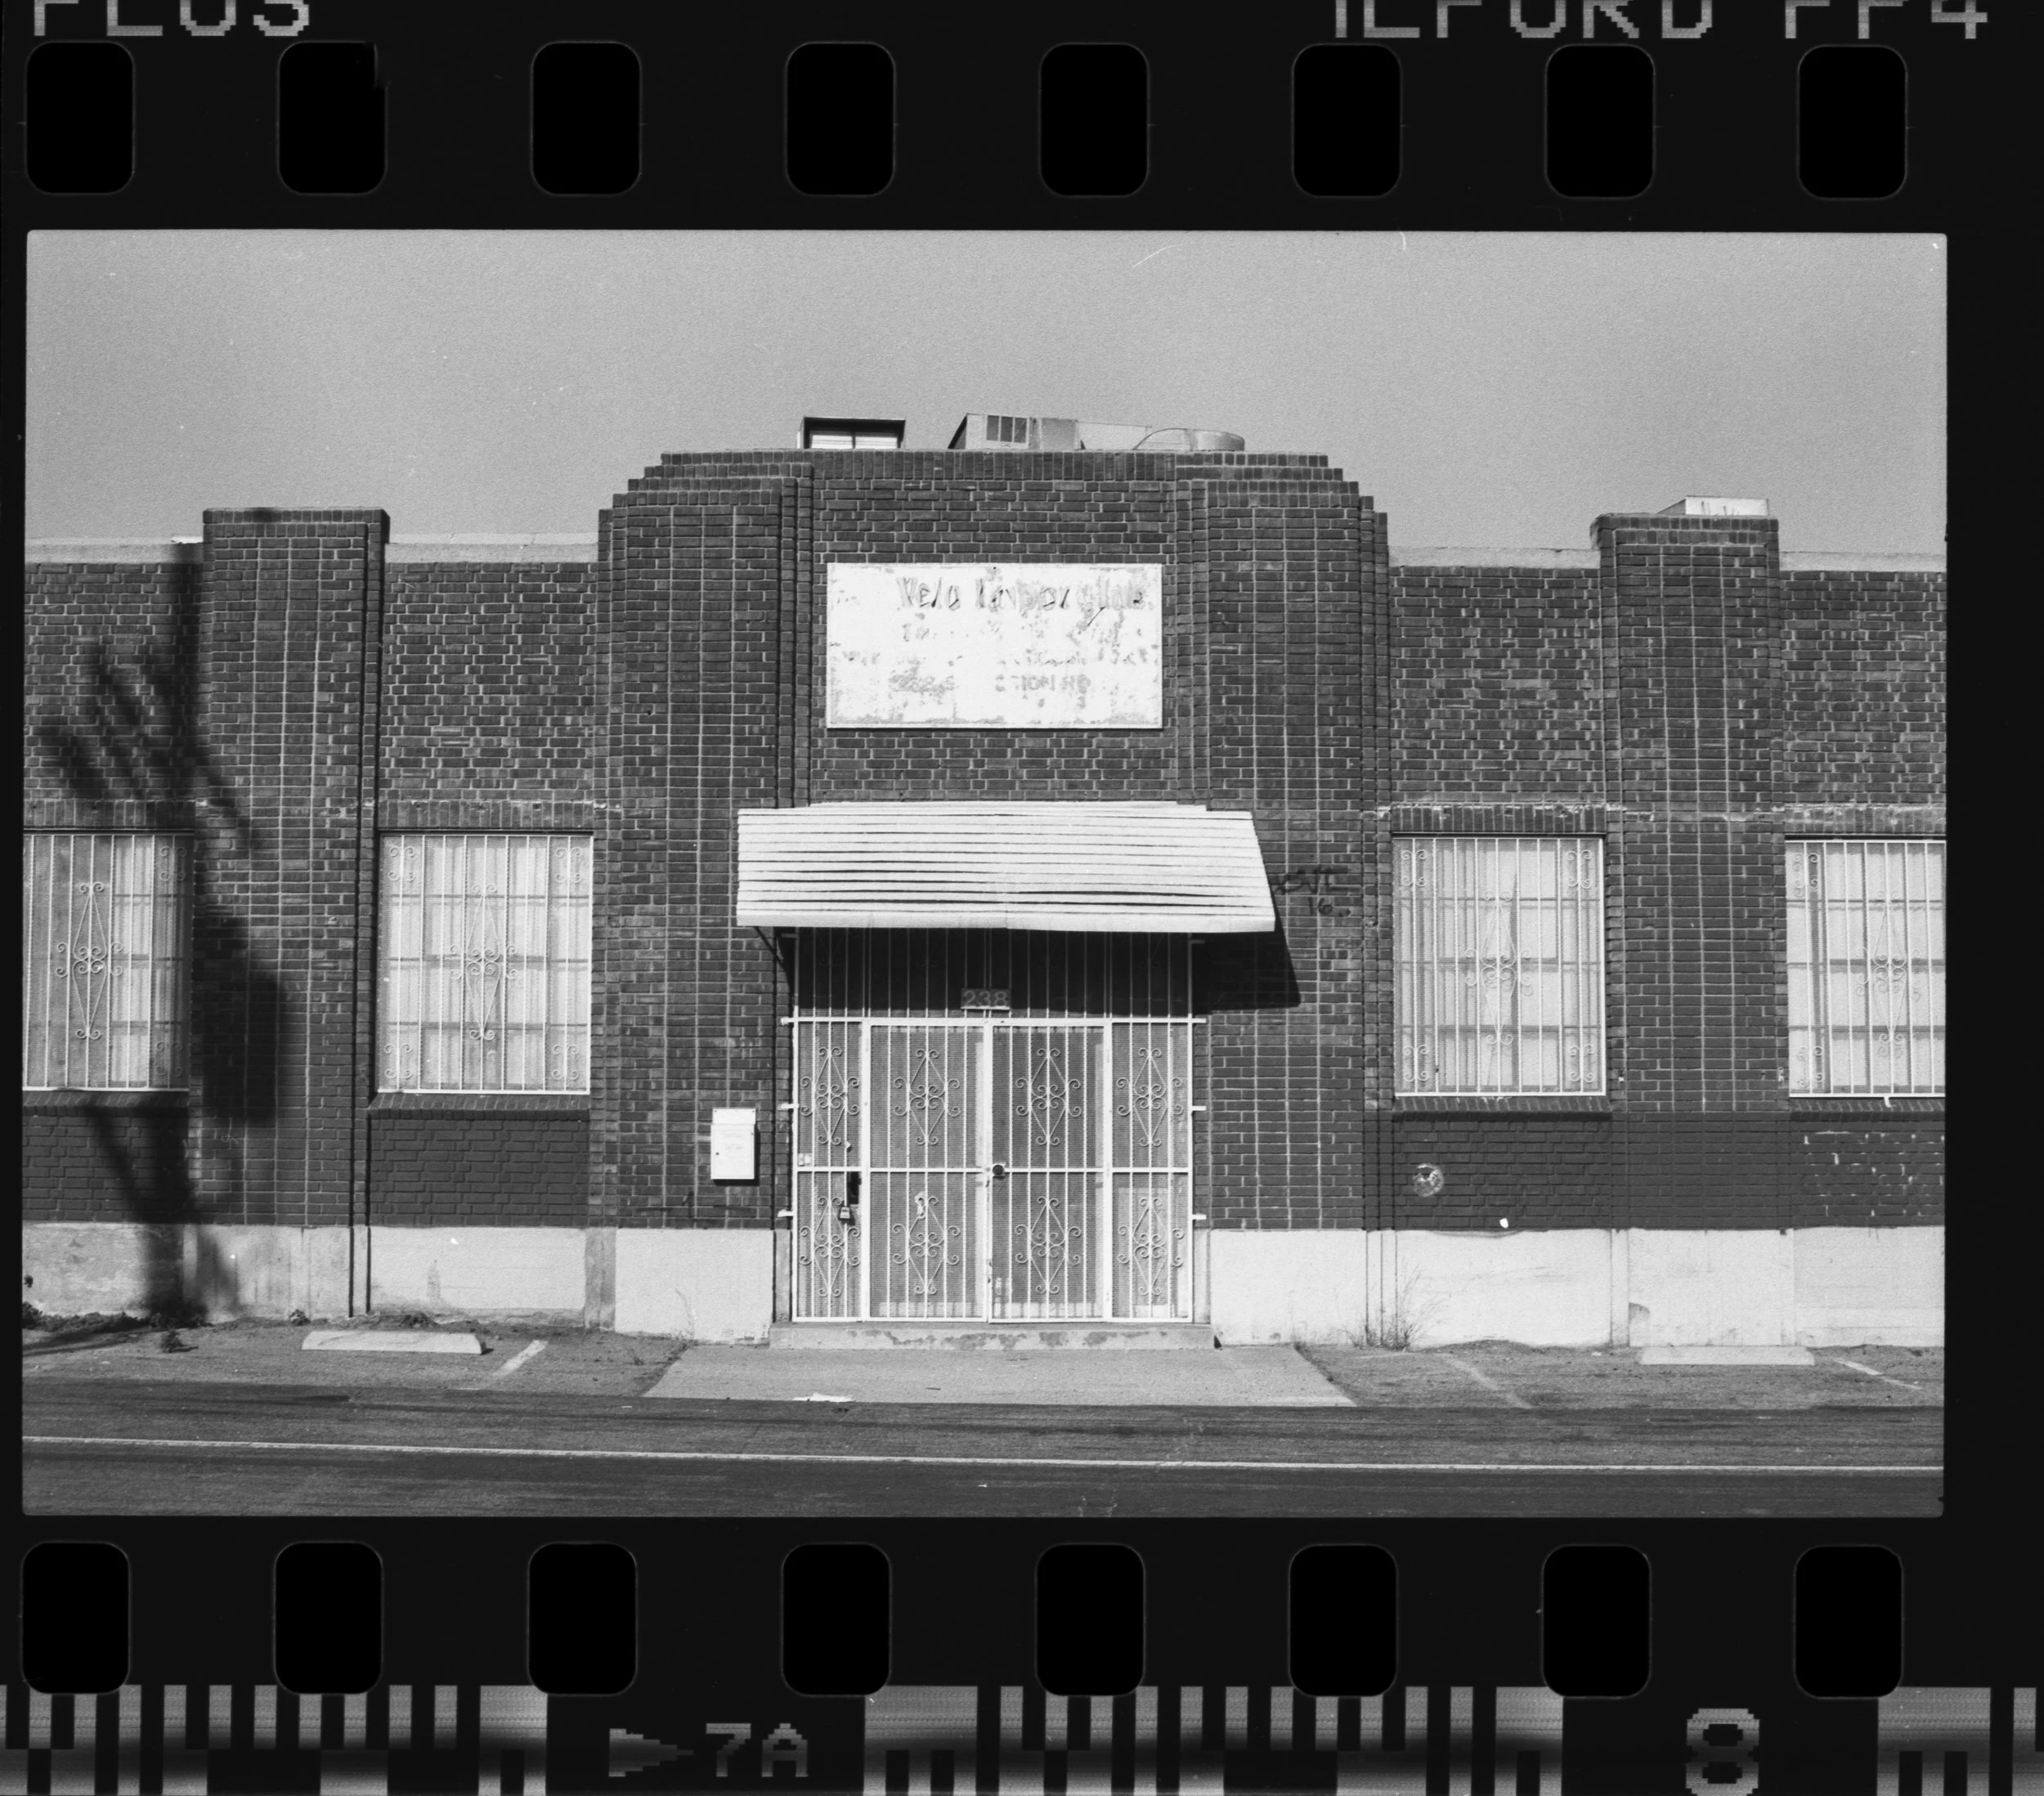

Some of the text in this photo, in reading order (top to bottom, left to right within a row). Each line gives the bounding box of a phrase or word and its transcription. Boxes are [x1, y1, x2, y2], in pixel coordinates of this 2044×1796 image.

[963, 990, 1008, 1006] 238
[706, 1722, 808, 1777] 7A
[1686, 1708, 1759, 1796] 8
